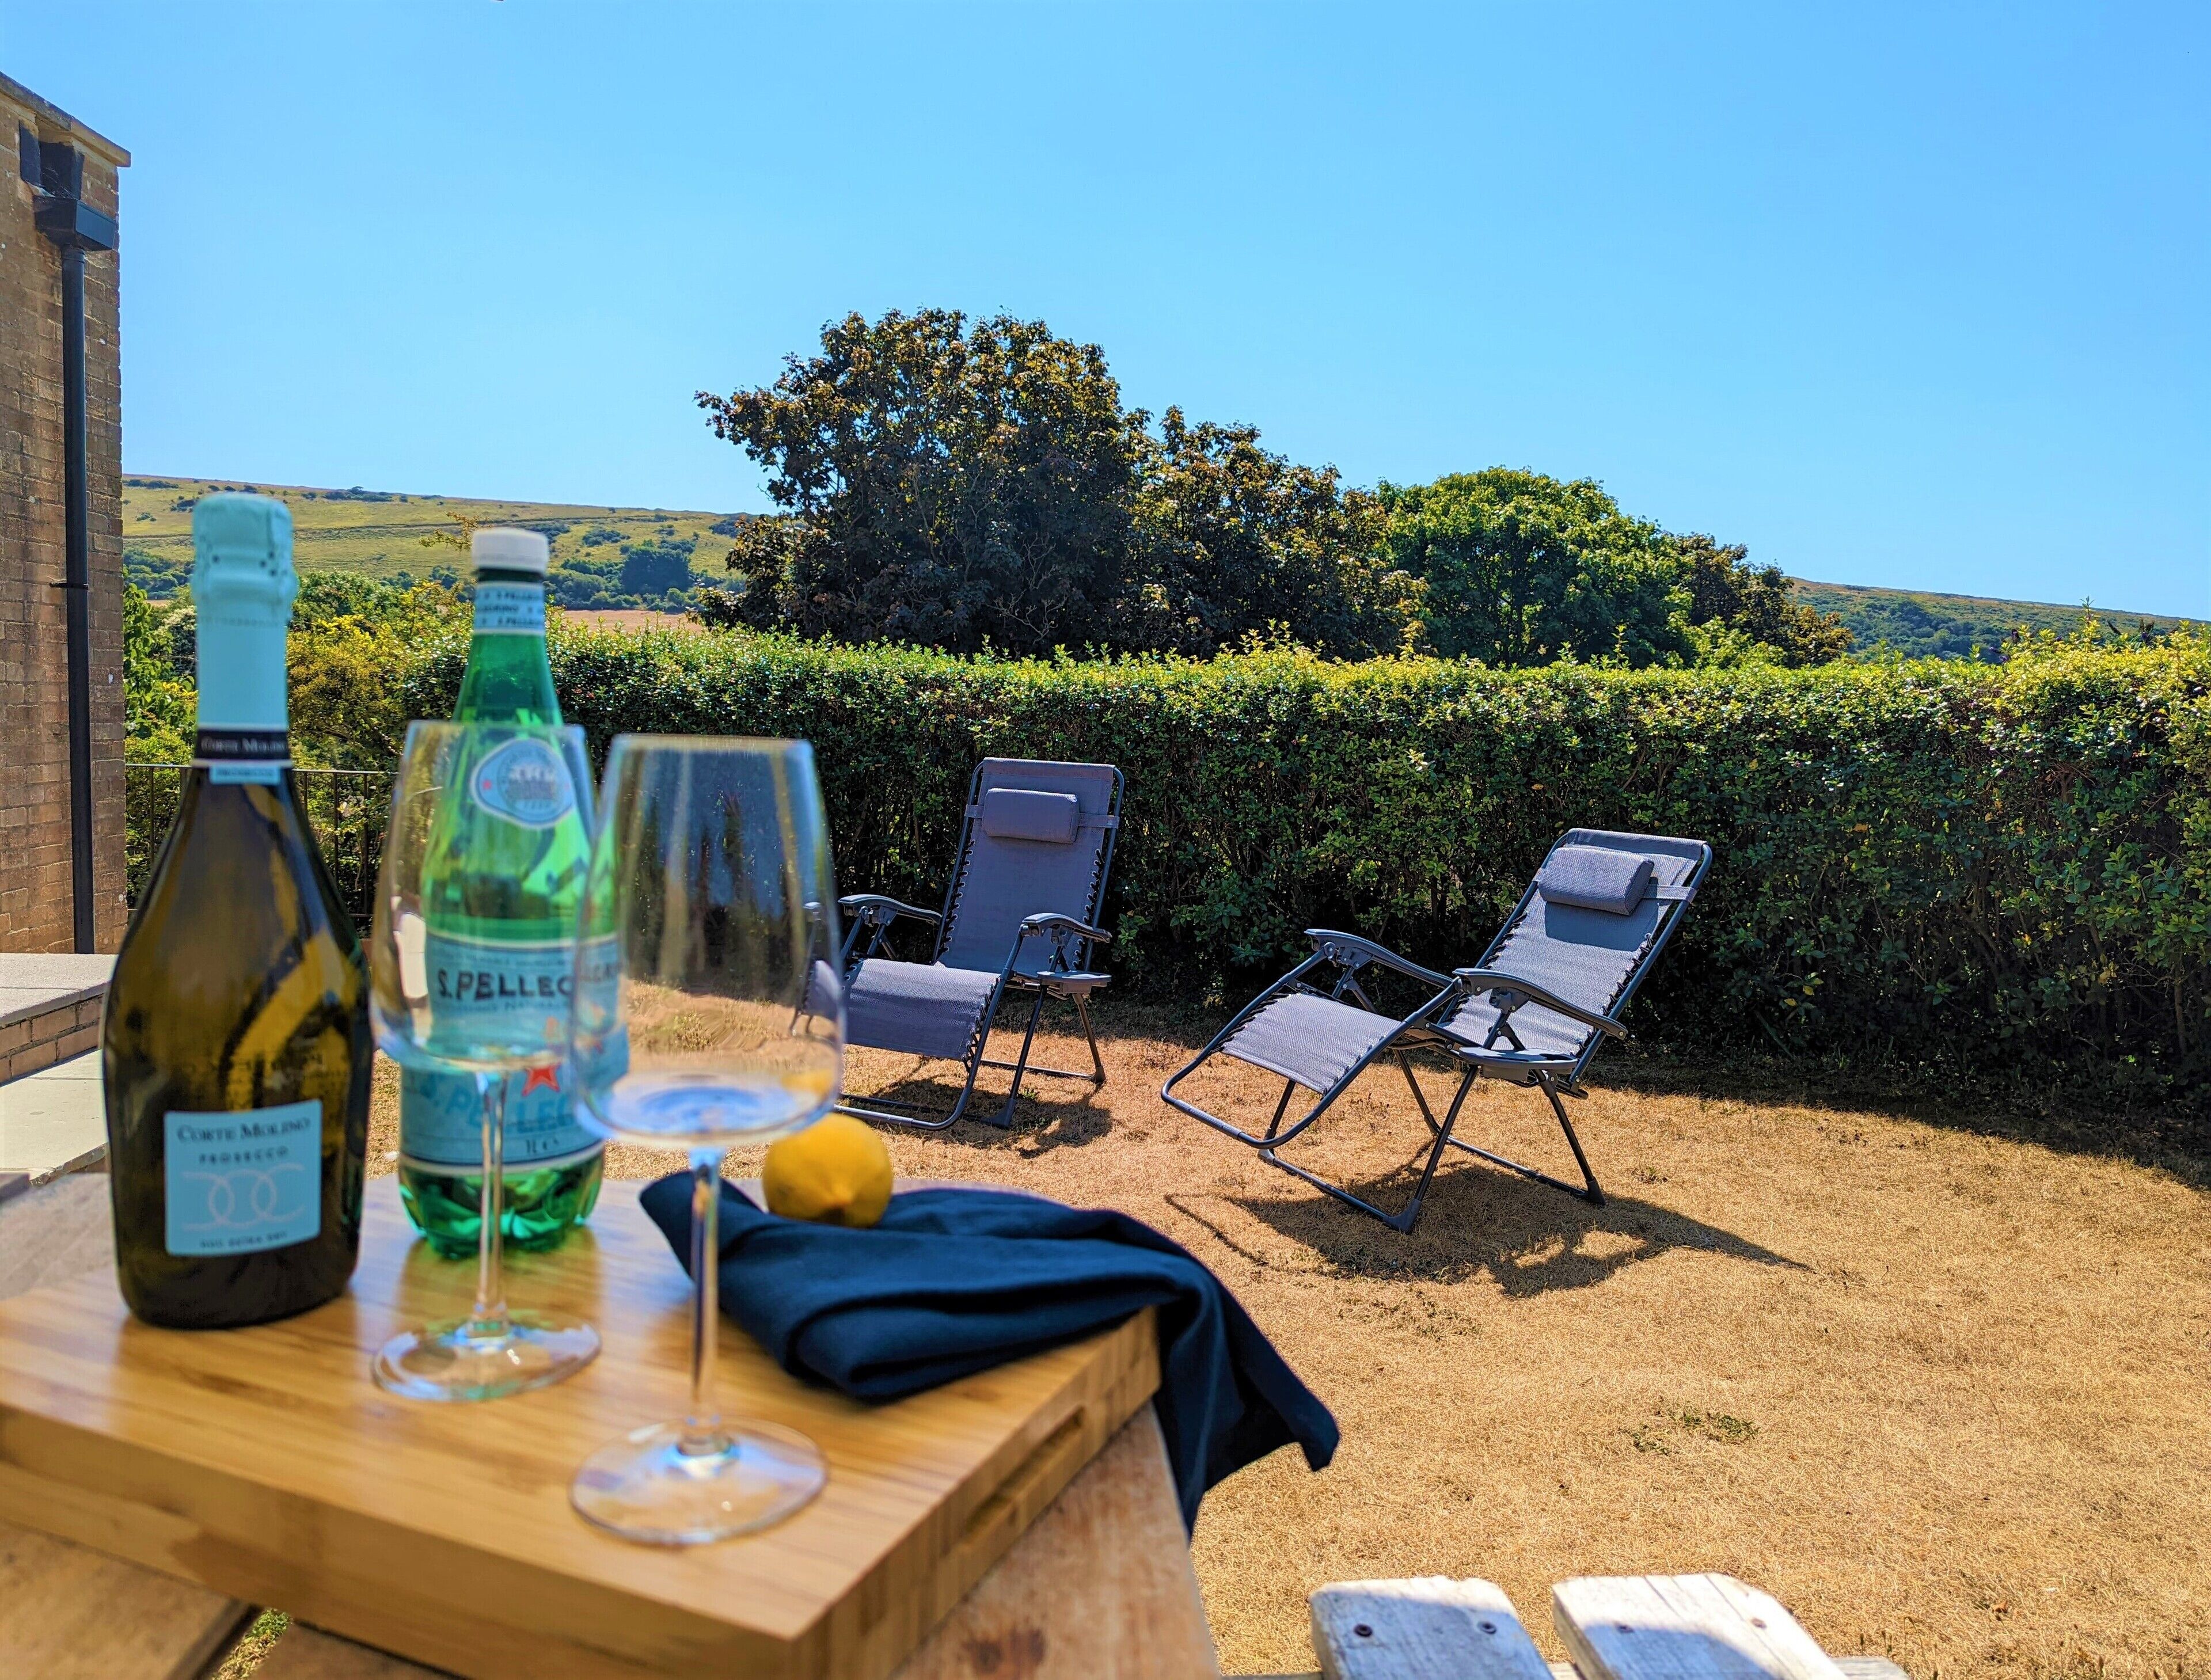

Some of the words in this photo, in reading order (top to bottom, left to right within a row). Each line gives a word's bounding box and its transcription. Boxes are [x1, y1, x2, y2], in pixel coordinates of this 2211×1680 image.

[176, 1124, 237, 1143] CORTE
[240, 1117, 311, 1139] MOLINO
[198, 1146, 288, 1164] PROSECCO
